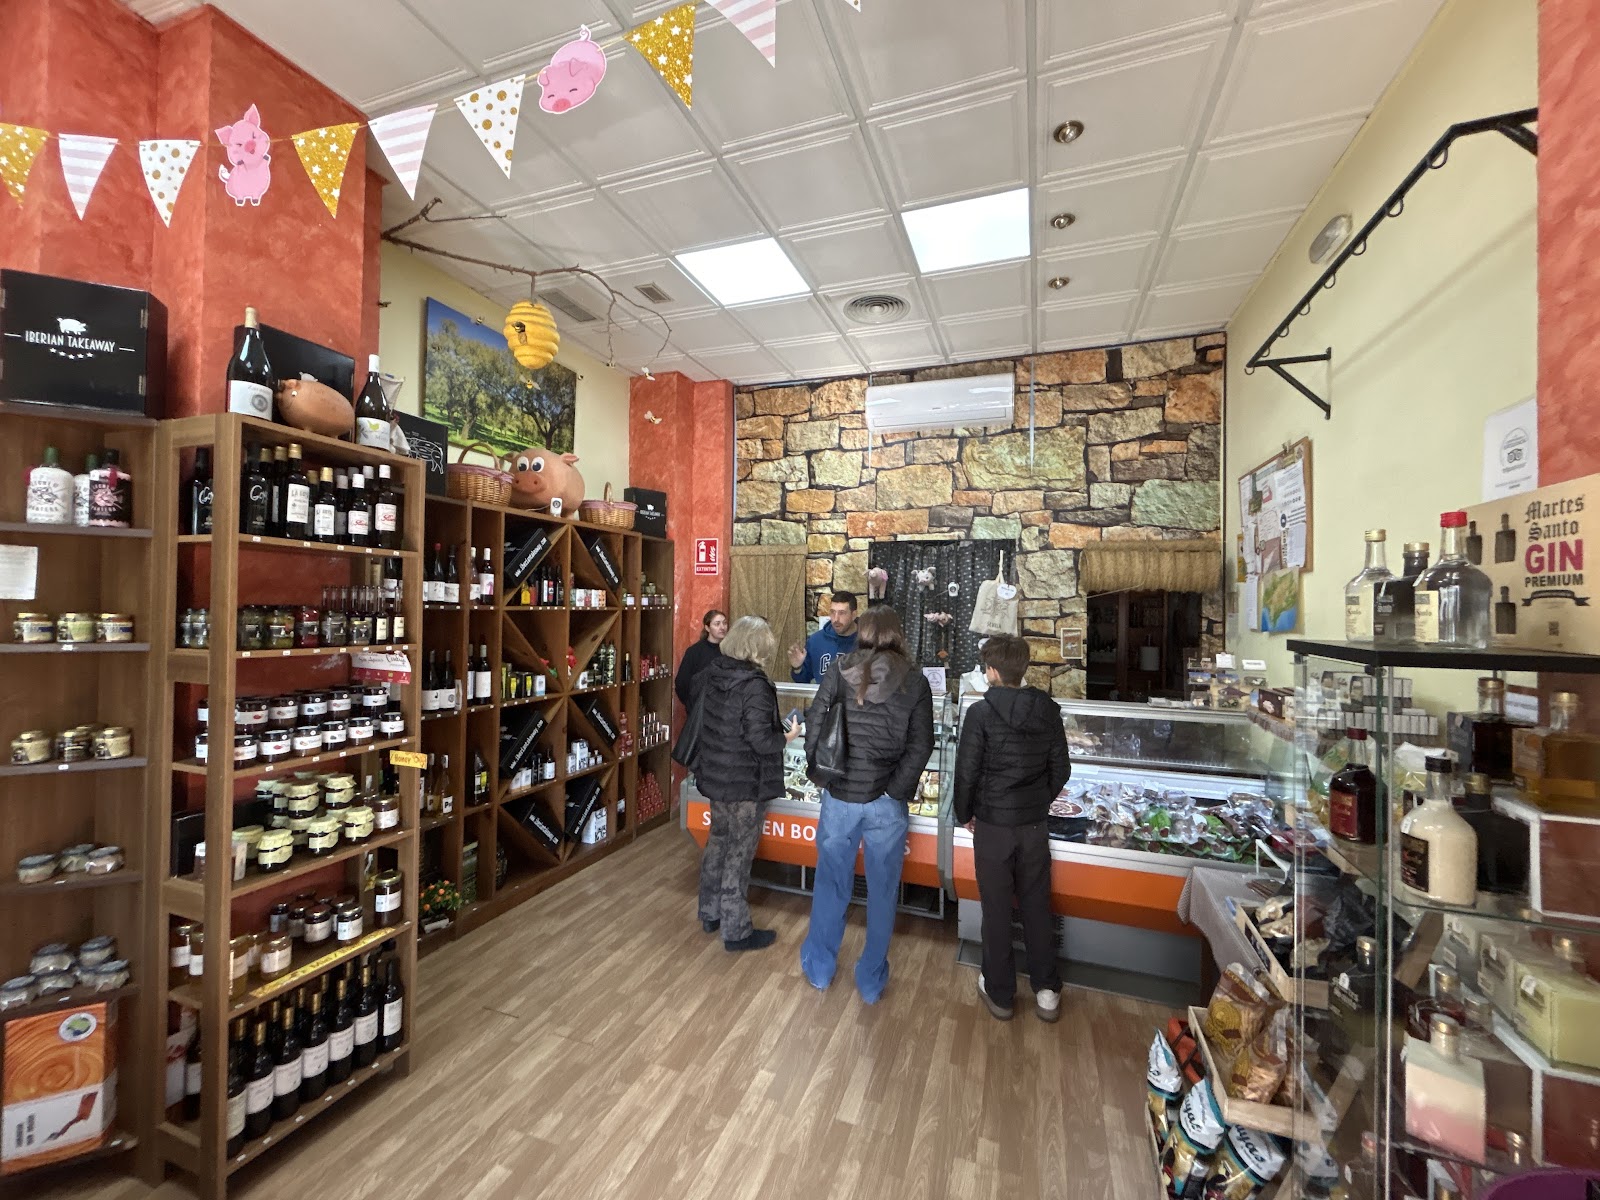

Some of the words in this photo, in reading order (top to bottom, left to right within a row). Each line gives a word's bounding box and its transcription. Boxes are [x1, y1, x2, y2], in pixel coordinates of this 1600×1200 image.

[25, 330, 65, 346] IBERIAN
[67, 336, 116, 352] TAKEAWAY
[1524, 496, 1586, 523] Martes
[1528, 519, 1580, 543] Santo
[1525, 538, 1584, 575] GIN
[1524, 573, 1585, 588] PREMIUM
